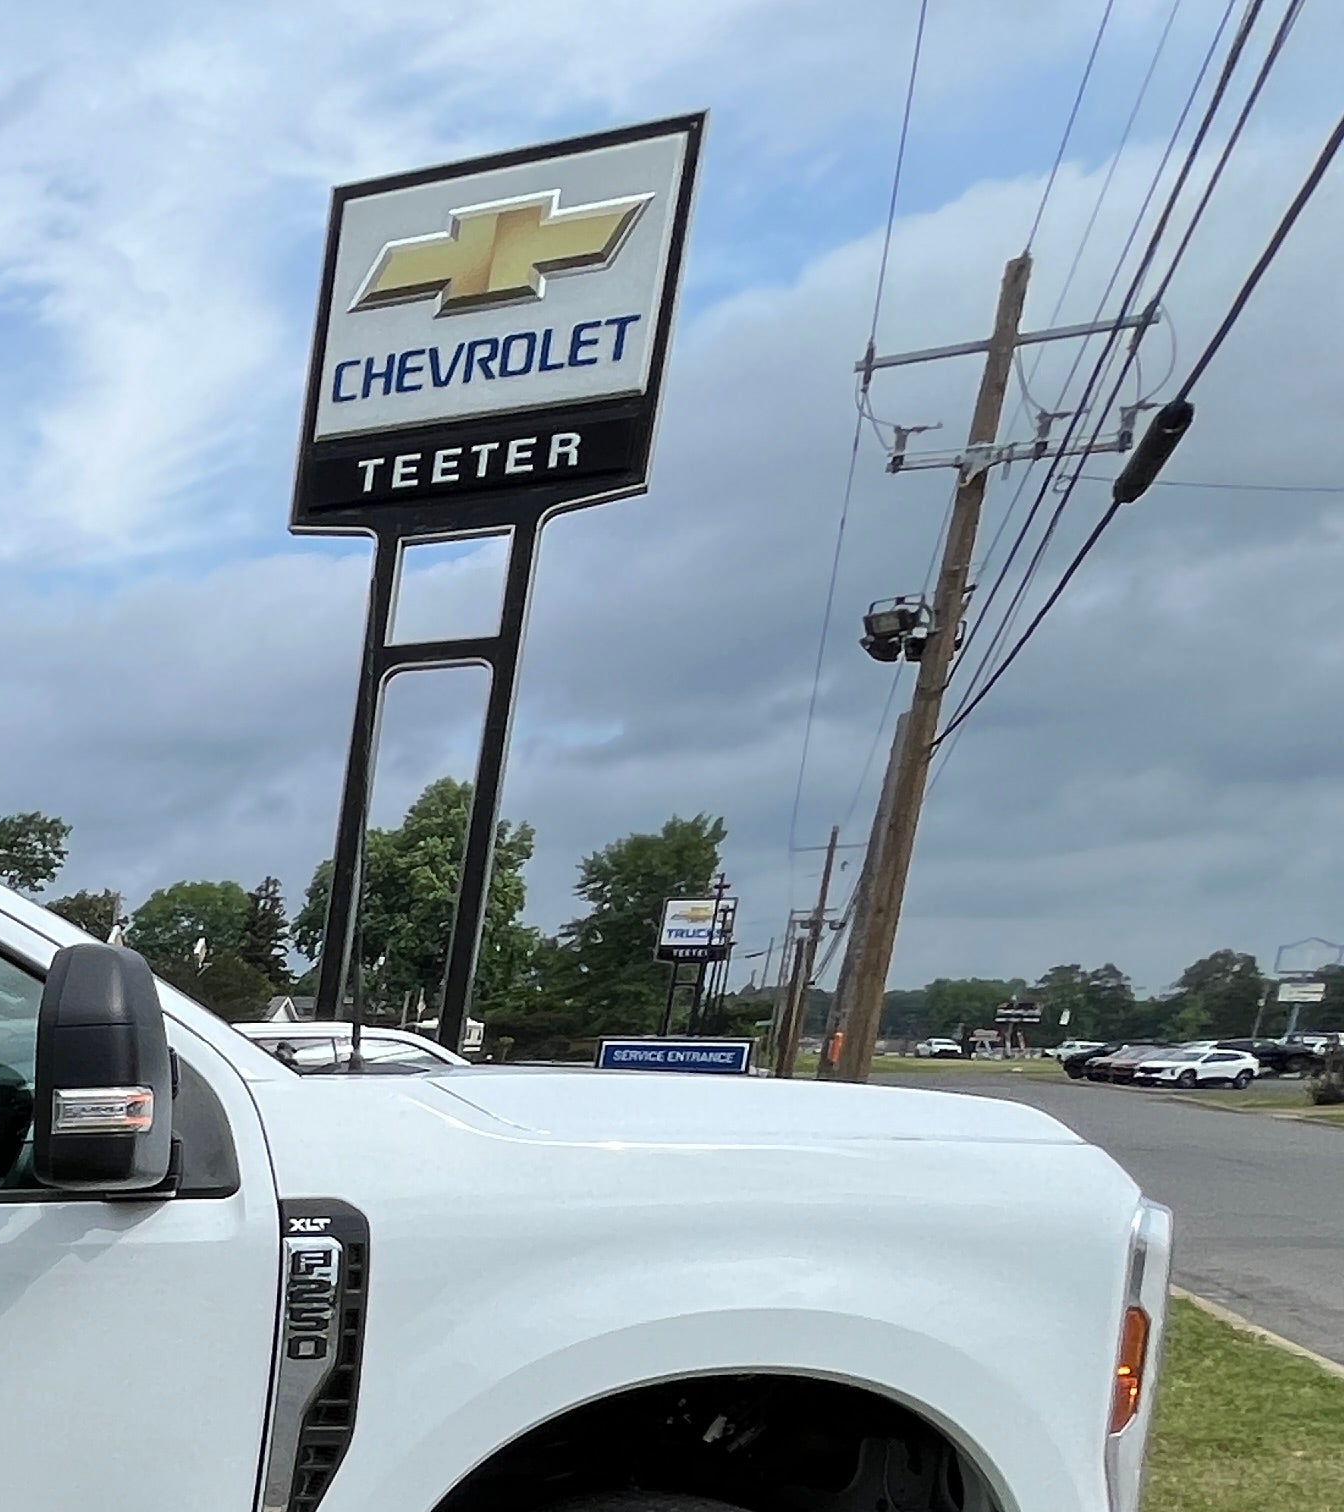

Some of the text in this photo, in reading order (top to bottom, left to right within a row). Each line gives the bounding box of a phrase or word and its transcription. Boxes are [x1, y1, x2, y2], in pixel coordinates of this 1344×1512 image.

[332, 314, 641, 402] CHEVROLET
[358, 432, 582, 493] TEETER
[613, 1050, 735, 1063] SERVICE ENTRANCE
[289, 1218, 331, 1232] XLT
